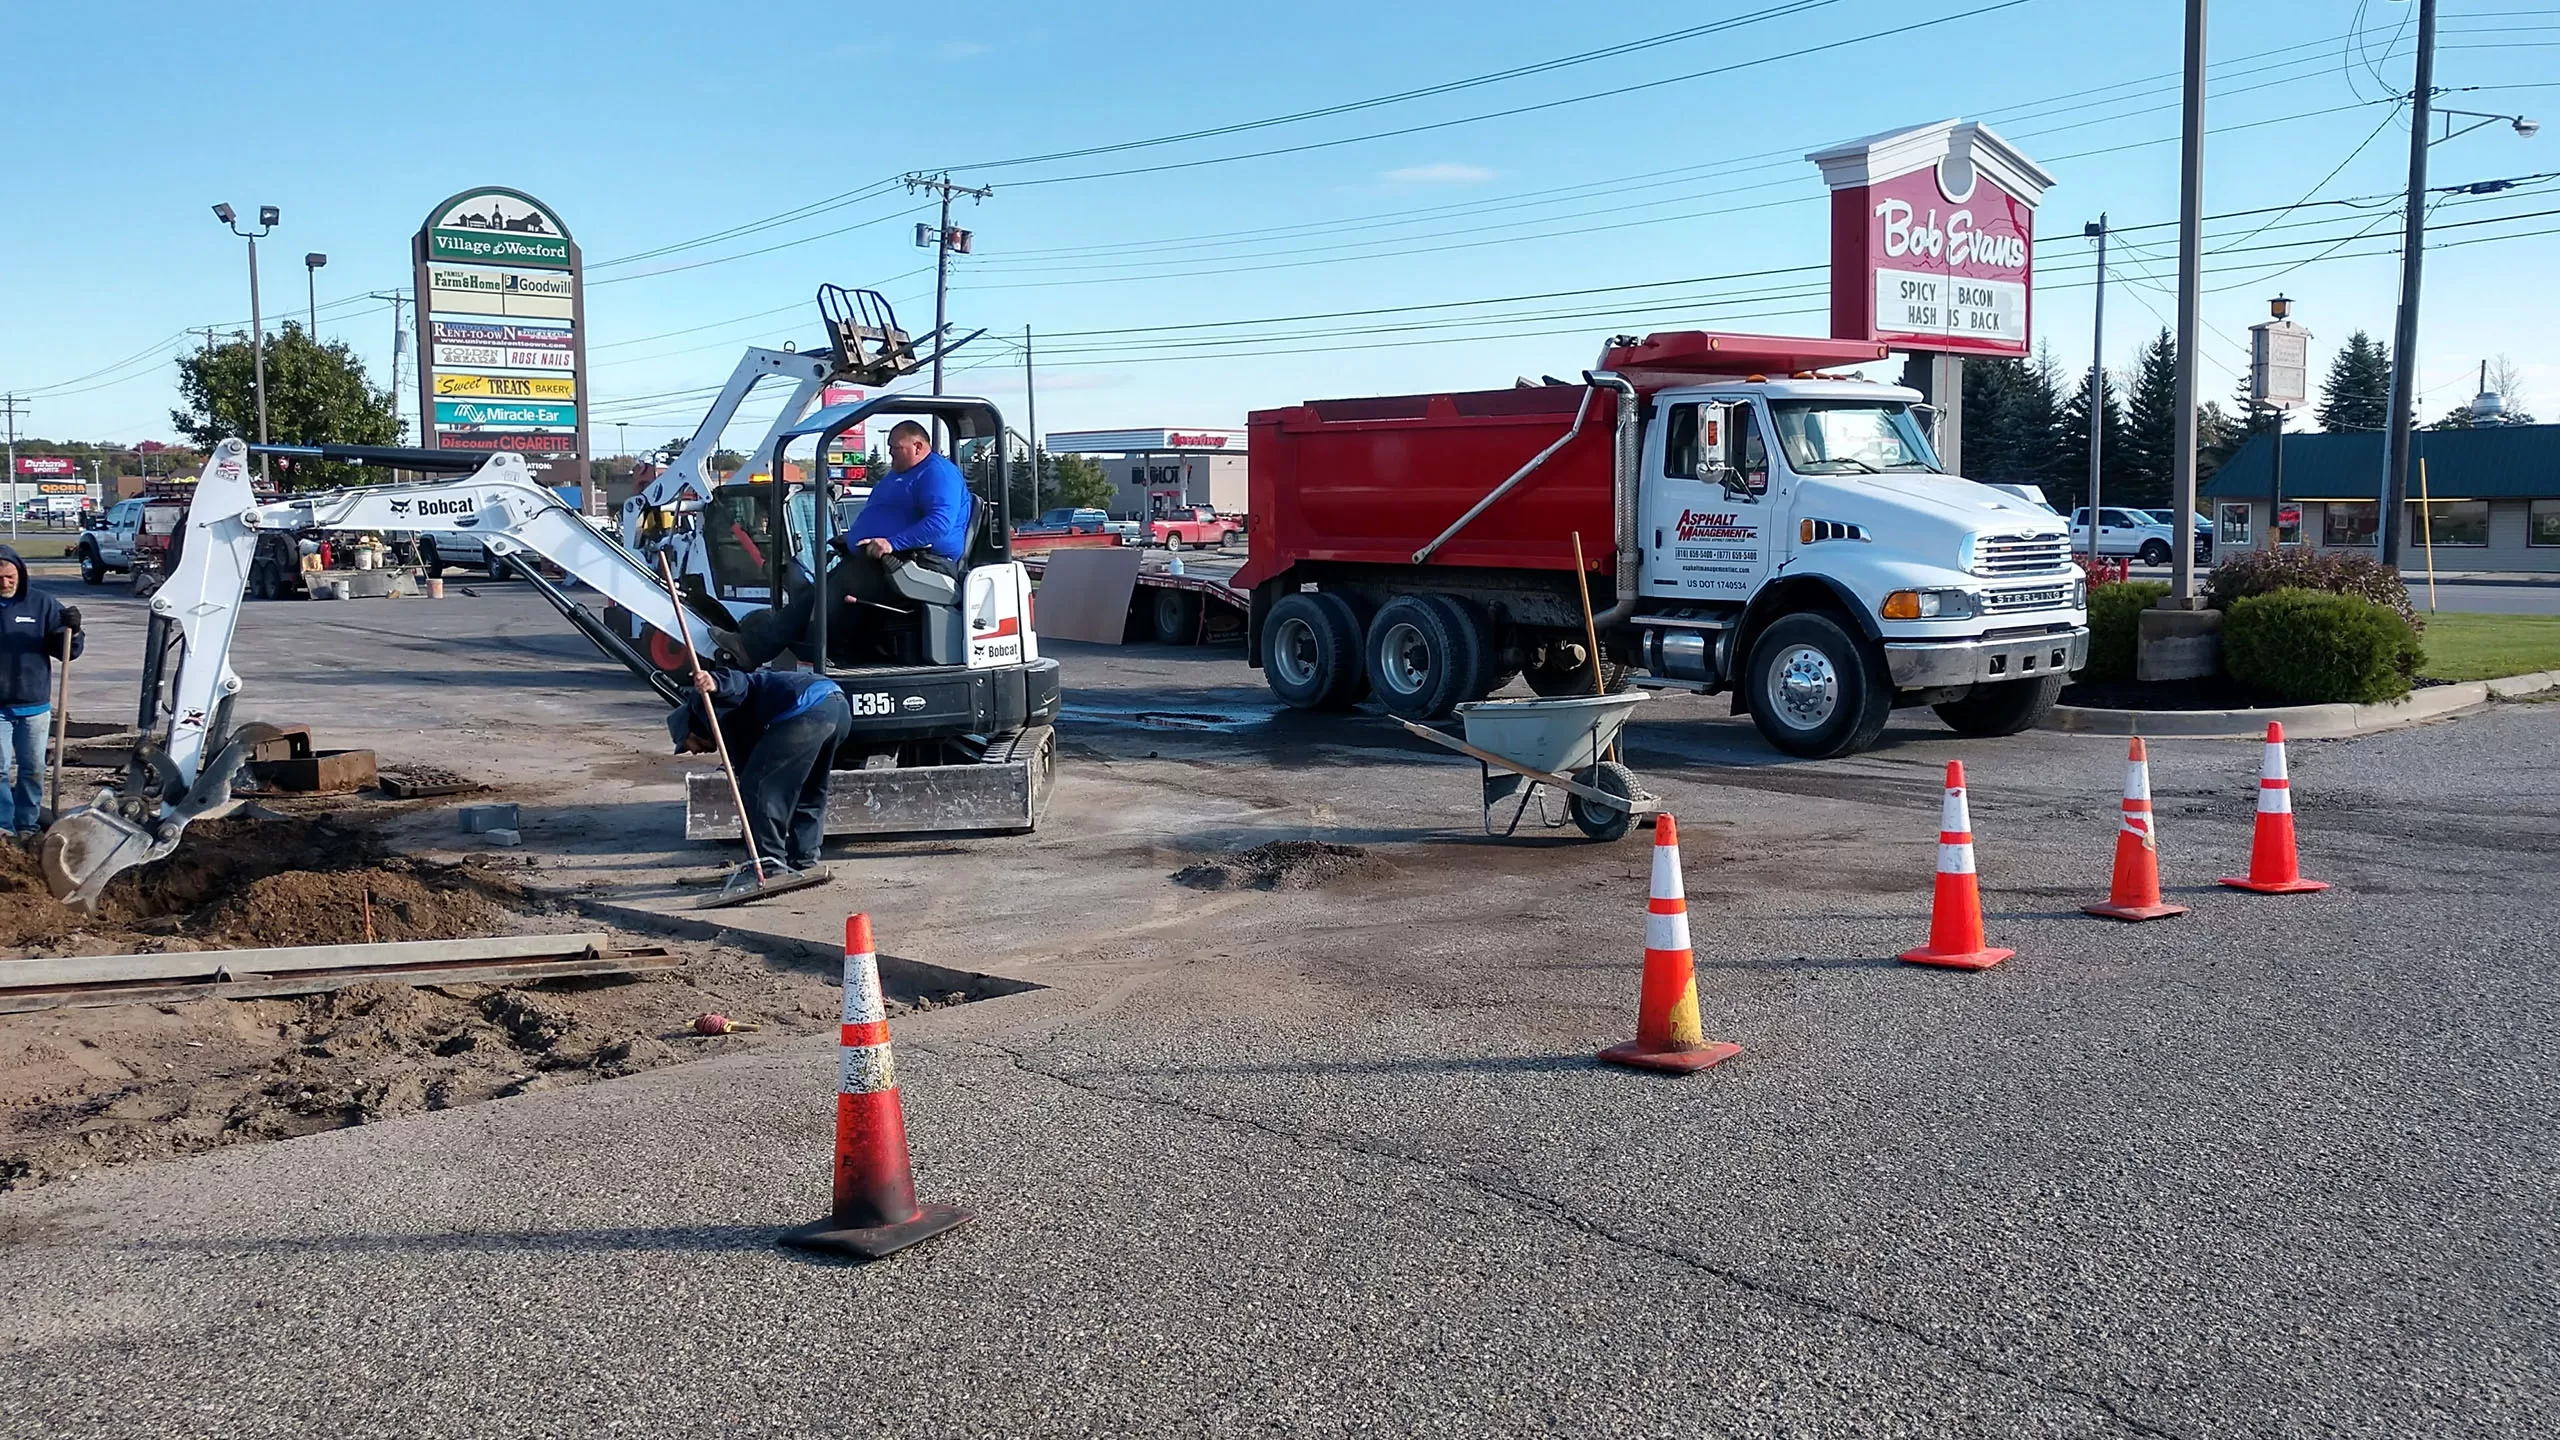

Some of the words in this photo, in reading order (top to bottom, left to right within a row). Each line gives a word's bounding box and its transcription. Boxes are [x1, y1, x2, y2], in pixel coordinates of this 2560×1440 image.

[1874, 198, 1943, 258] Bob
[1945, 209, 2026, 269] Evans
[436, 236, 491, 255] Village
[504, 242, 567, 258] Wexford
[434, 272, 501, 290] Farm&Home
[444, 270, 464, 278] FAMILY
[519, 278, 571, 294] Goodwill
[1900, 280, 1936, 302] SPICY
[1958, 286, 1993, 307] BACON
[1908, 305, 1936, 326] HASH
[1948, 309, 1959, 327] IS
[1971, 311, 2000, 331] BACK
[441, 347, 499, 357] GOLDEN
[511, 351, 537, 365] ROSE
[541, 352, 570, 366] NAILS
[440, 377, 482, 394] Sweet
[488, 378, 531, 396] TREATS
[535, 384, 570, 394] BAKERY
[486, 409, 560, 422] Miracle-Ear
[441, 437, 500, 449] Discount
[500, 435, 570, 450] CIGARETTE
[1168, 432, 1229, 448] Speedway
[40, 484, 85, 494] QDOBA
[418, 498, 474, 516] Bobcat
[1675, 509, 1738, 532] ASPHALT
[1678, 526, 1748, 541] MANAGEMENT
[1687, 580, 1698, 588] US
[1699, 580, 1715, 588] DOT
[1717, 581, 1747, 590] 1740534
[1997, 591, 2060, 603] STERLING
[988, 643, 1018, 658] Bobcat
[852, 692, 895, 716] E35i
